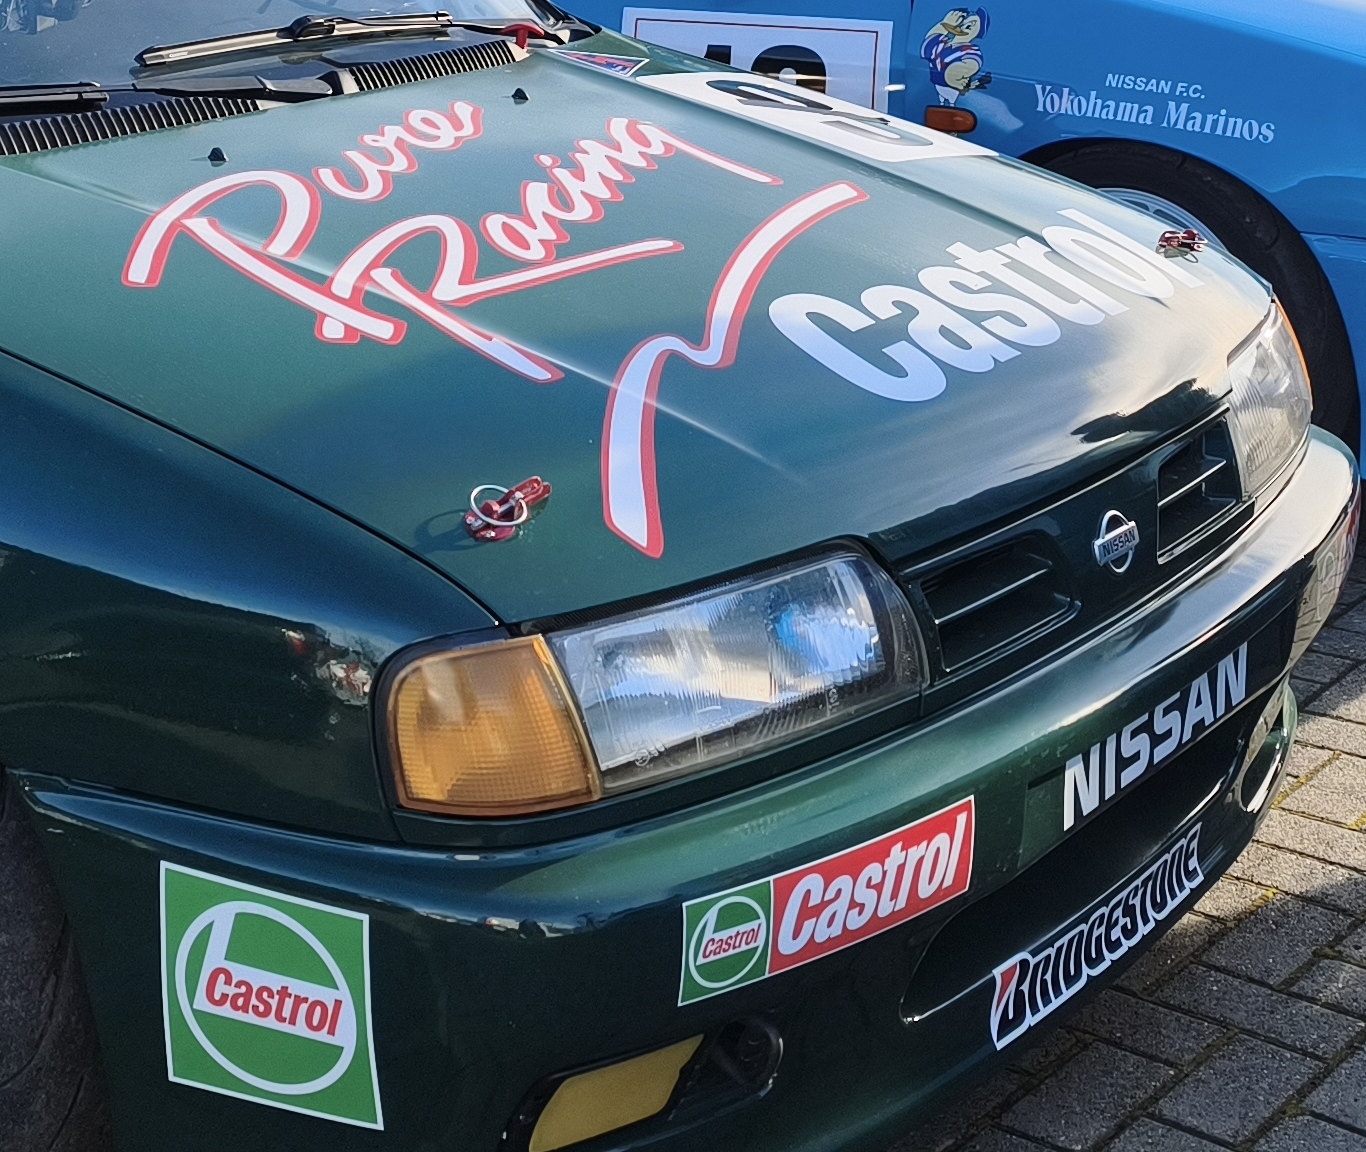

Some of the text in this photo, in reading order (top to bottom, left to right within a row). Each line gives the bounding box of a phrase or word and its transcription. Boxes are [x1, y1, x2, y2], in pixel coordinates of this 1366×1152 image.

[1034, 83, 1275, 144] Yokohama Marinos
[1104, 73, 1206, 99] NISSAN F.C.
[121, 100, 484, 346] Pure
[316, 116, 783, 383] Racing
[767, 207, 1205, 403] Castrol
[1102, 528, 1136, 558] NISSAN
[1062, 642, 1249, 832] NISSAN
[702, 810, 967, 960] Castrol Castrol
[992, 826, 1205, 1049] BRIDGESTONE
[204, 966, 342, 1036] Castrol
